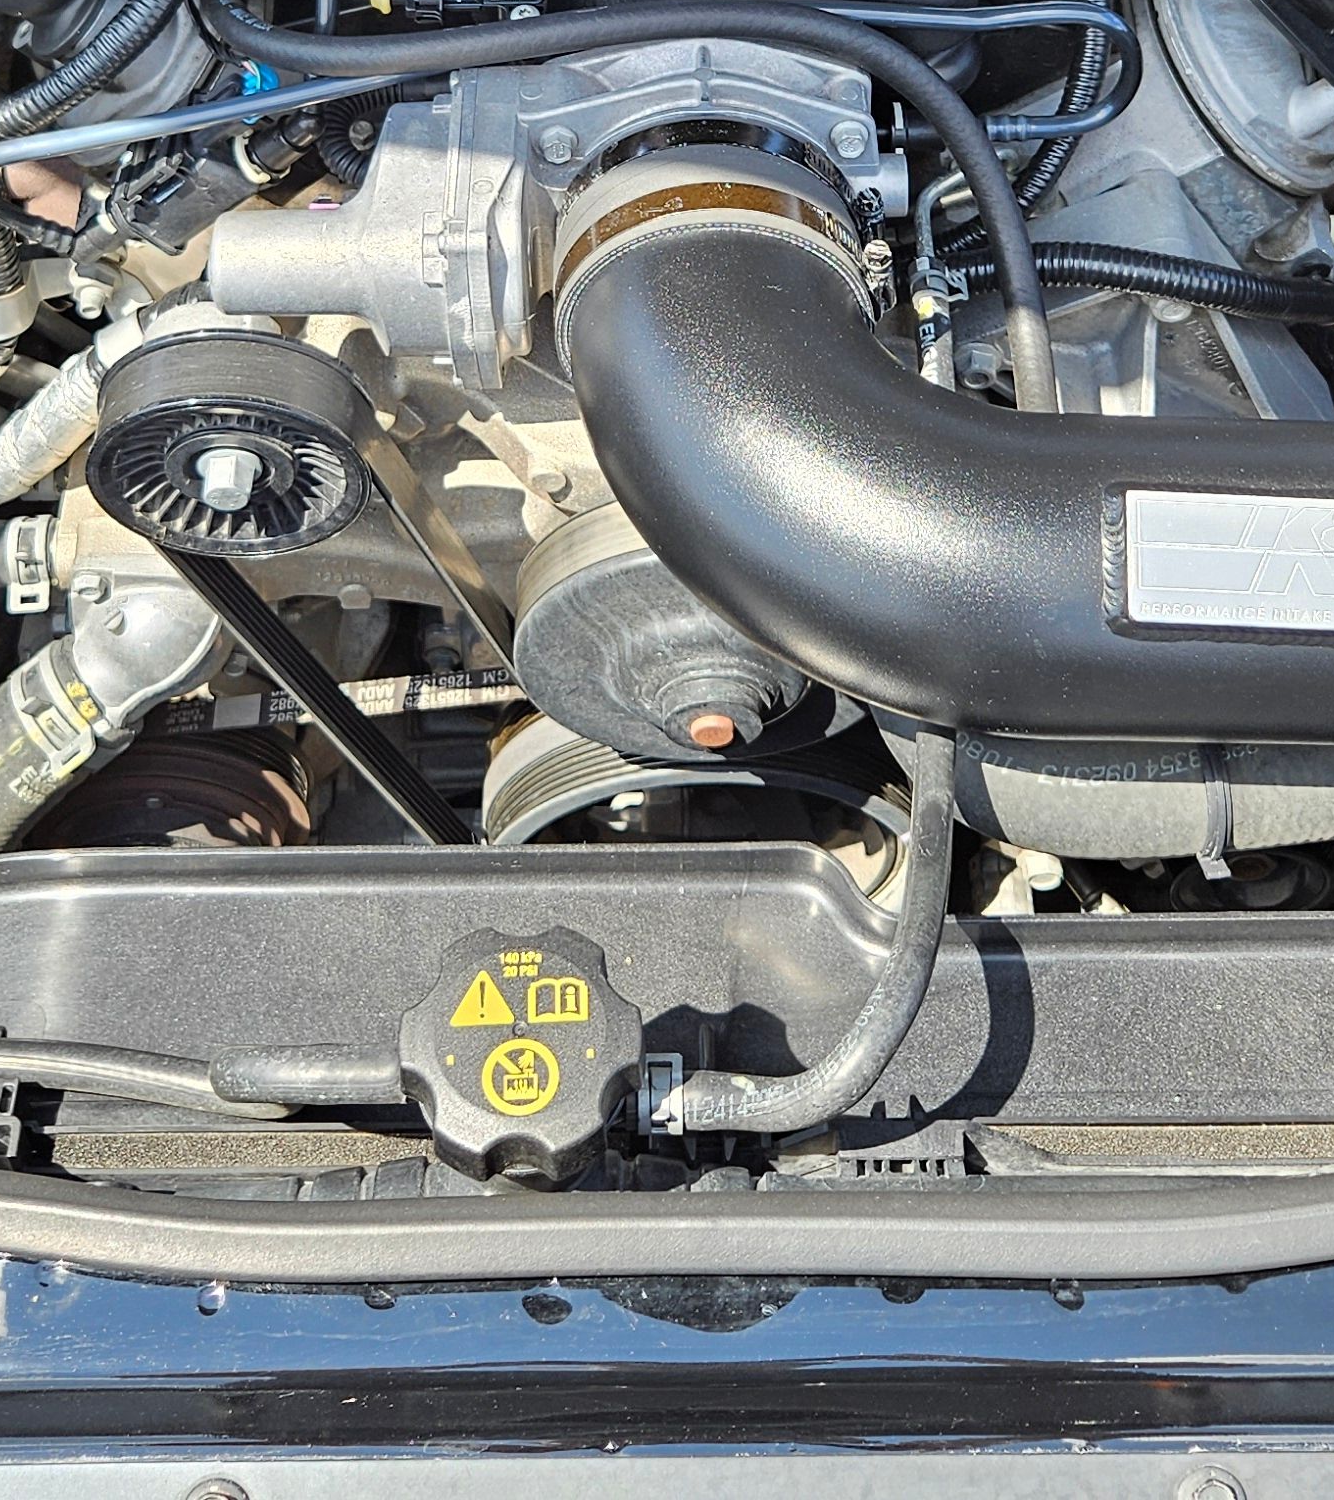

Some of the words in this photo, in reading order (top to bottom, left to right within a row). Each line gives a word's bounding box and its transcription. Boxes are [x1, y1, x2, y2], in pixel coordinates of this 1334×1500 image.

[1140, 601, 1266, 622] PERFORMANCE
[1272, 607, 1333, 625] INTAKE
[481, 668, 509, 684] GM
[499, 952, 519, 964] 140
[520, 951, 543, 963] kPa
[502, 965, 518, 978] 20
